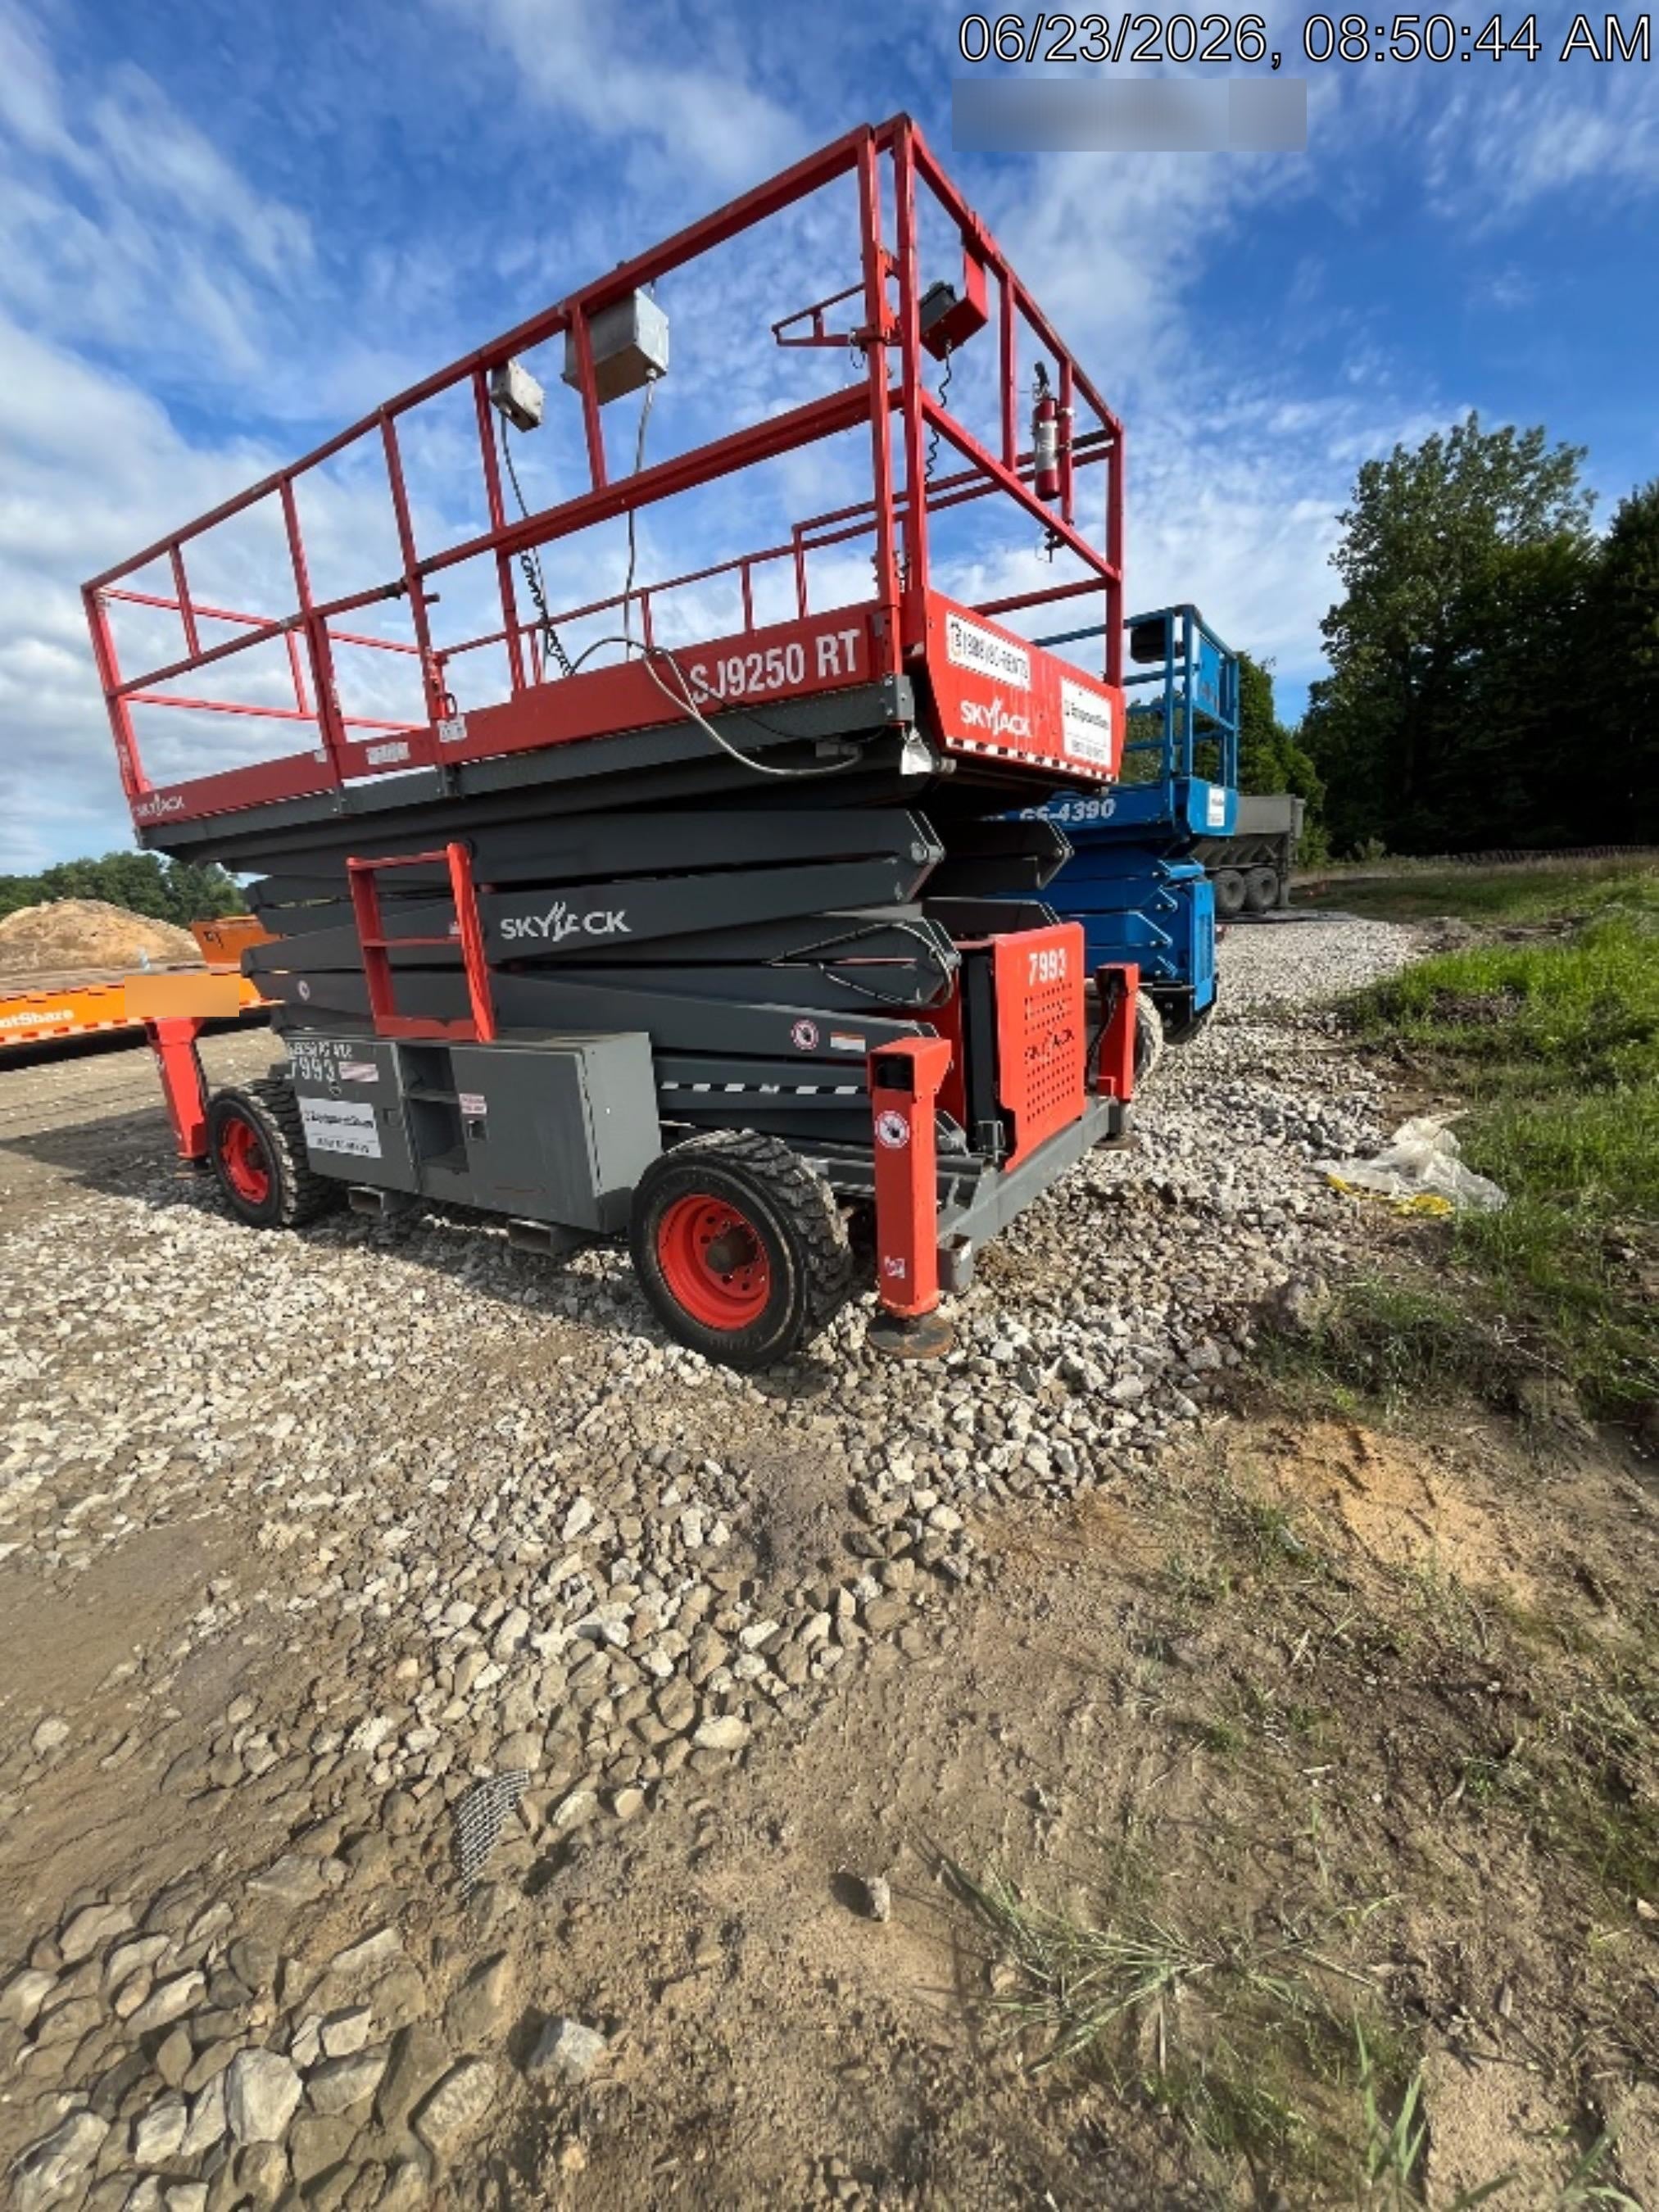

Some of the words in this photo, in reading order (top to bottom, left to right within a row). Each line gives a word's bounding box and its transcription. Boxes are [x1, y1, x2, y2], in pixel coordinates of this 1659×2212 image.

[689, 643, 805, 705] SJ9250
[815, 628, 860, 678] RT
[960, 696, 1032, 737] SKYJACK
